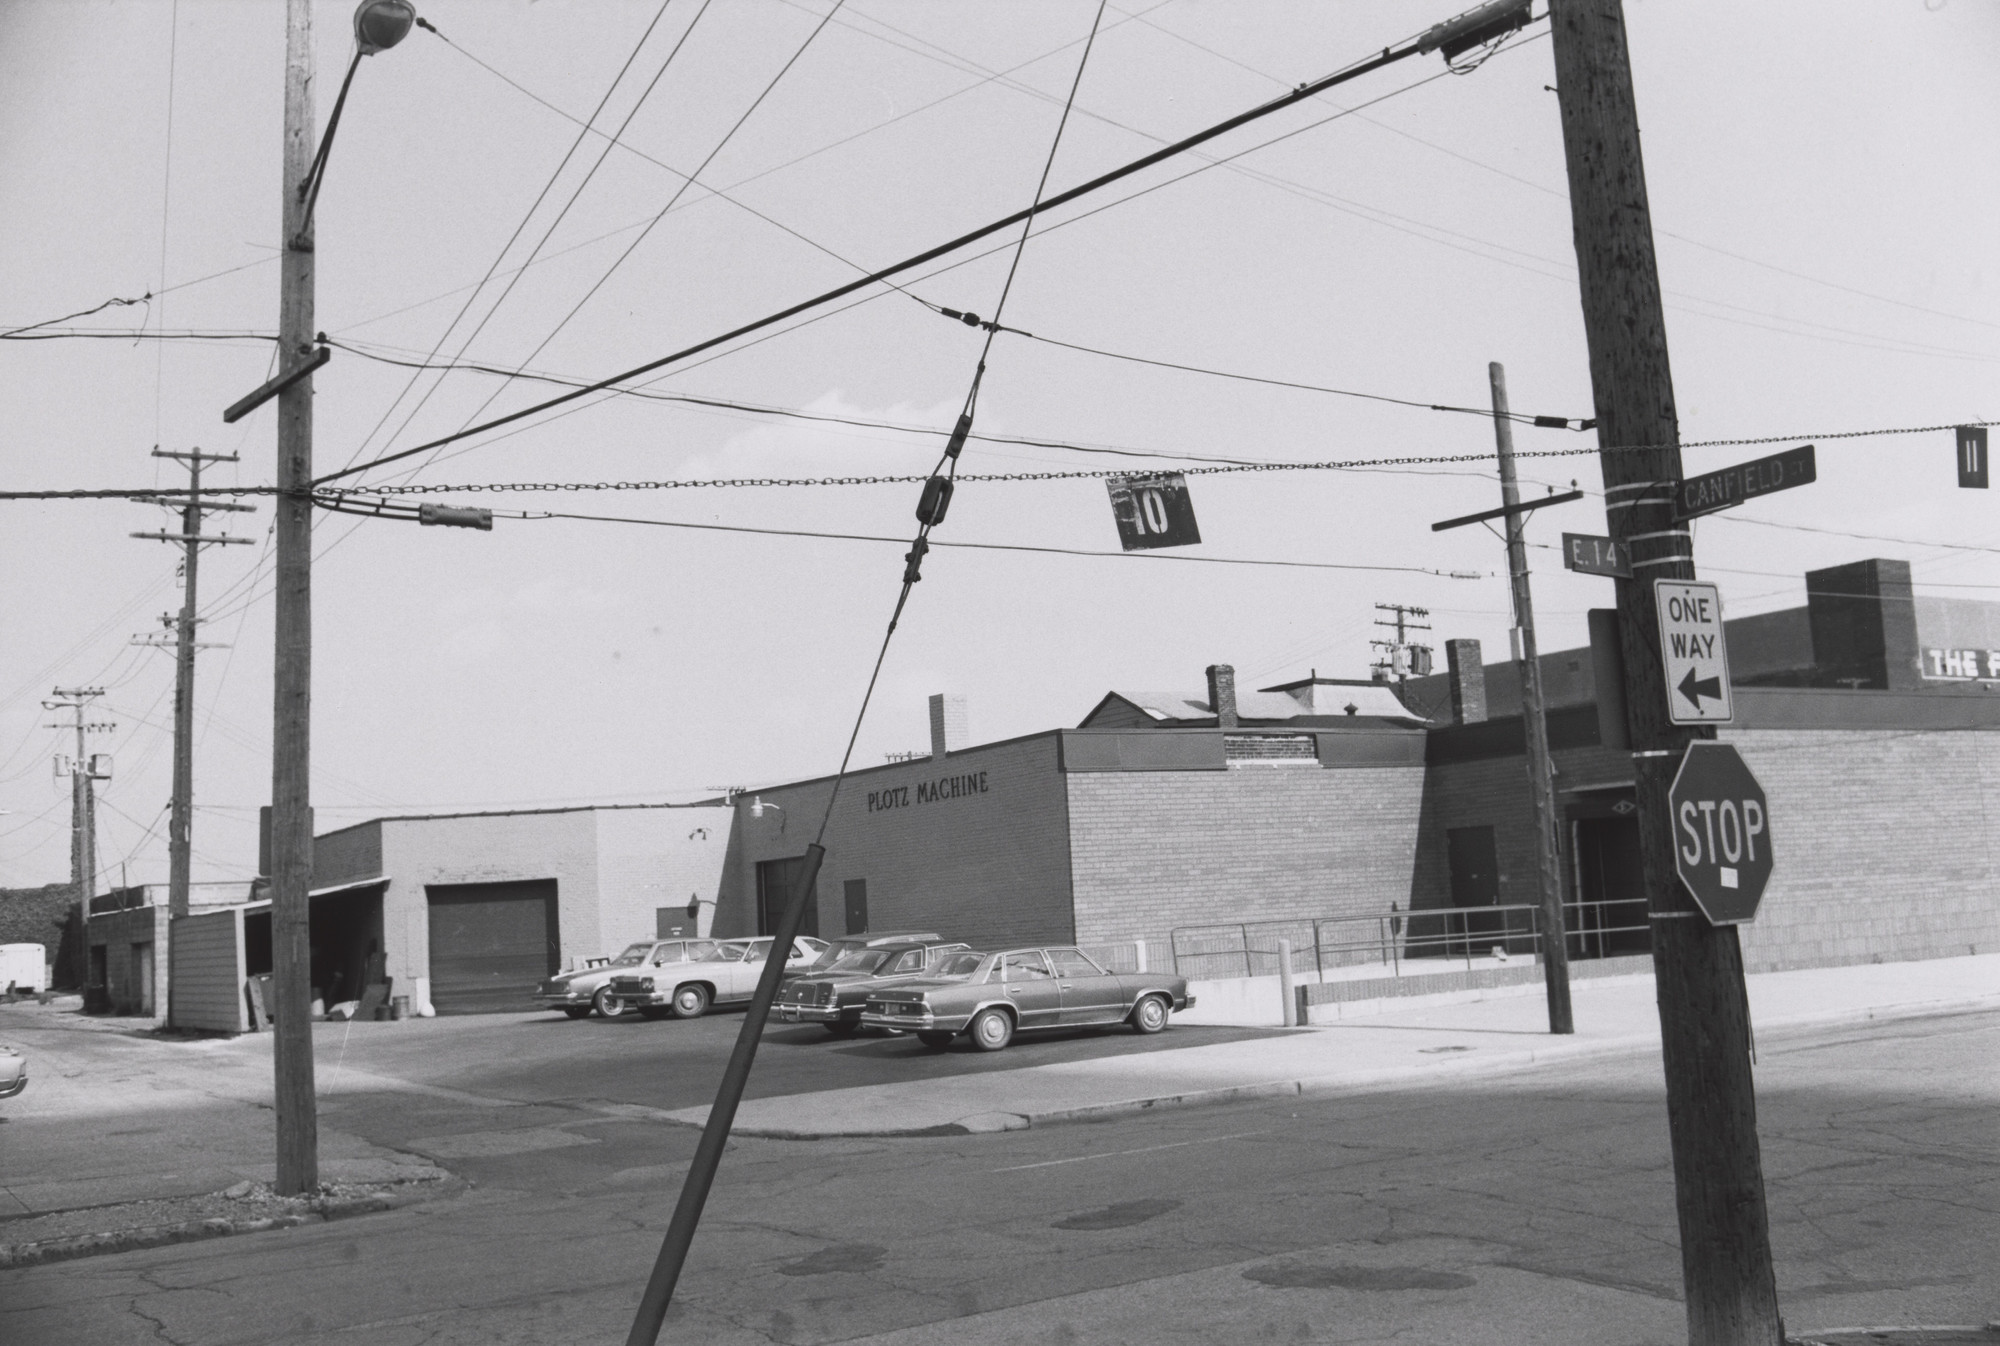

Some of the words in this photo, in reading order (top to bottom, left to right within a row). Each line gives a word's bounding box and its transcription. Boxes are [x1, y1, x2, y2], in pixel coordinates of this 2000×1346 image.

[1684, 460, 1783, 509] CANFIELD
[1668, 596, 1712, 624] ONE
[1670, 632, 1715, 659] WAY
[1929, 649, 1978, 677] THE
[868, 786, 909, 812] PLOTZ
[917, 771, 989, 804] MACHINE
[1680, 799, 1764, 866] STOP
